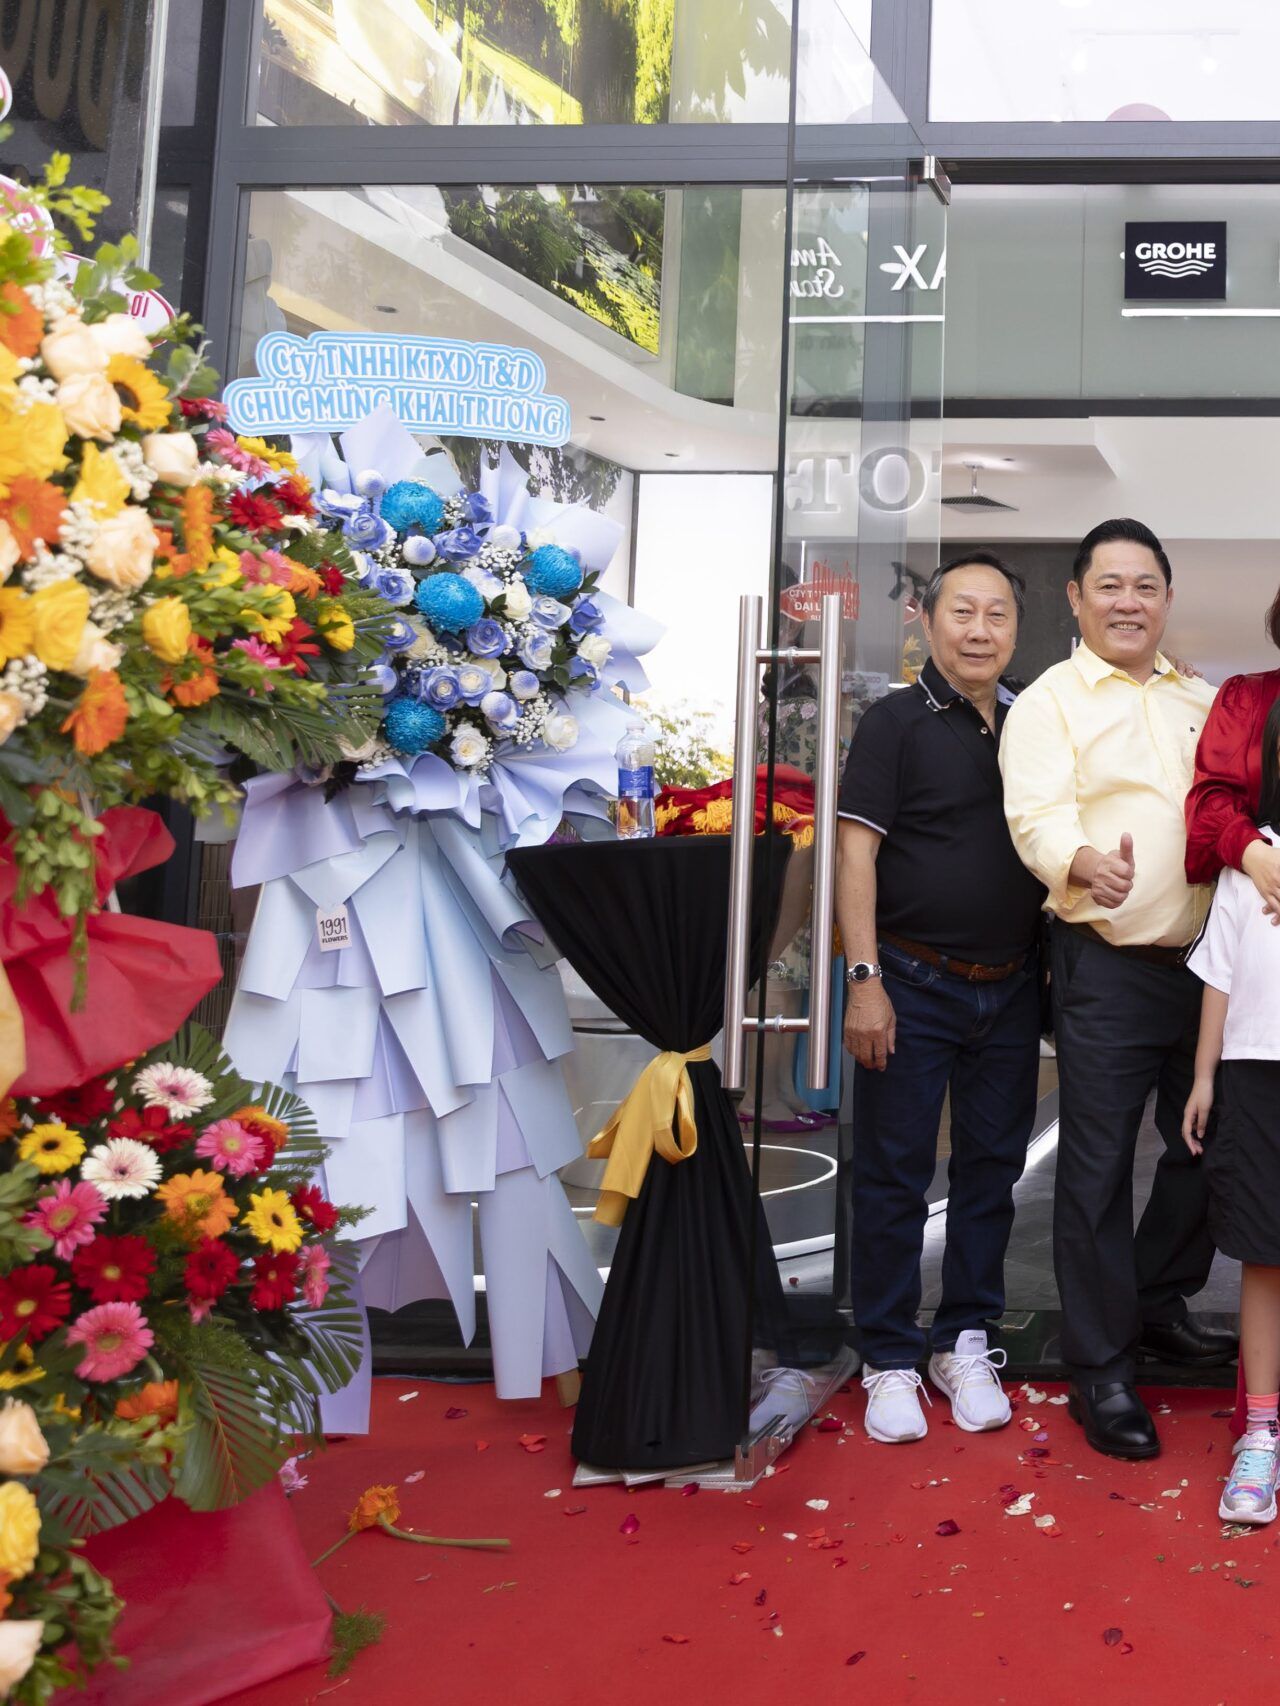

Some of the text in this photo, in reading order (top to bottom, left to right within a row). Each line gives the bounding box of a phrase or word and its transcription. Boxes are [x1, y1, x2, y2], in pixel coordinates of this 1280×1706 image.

[1135, 242, 1217, 260] GROHE
[270, 343, 534, 391] Cty TNHH KTXD T&D
[236, 380, 311, 425] CHÚC
[396, 388, 459, 426] KHAI
[320, 917, 347, 937] 1991
[321, 934, 349, 944] FLOWERS
